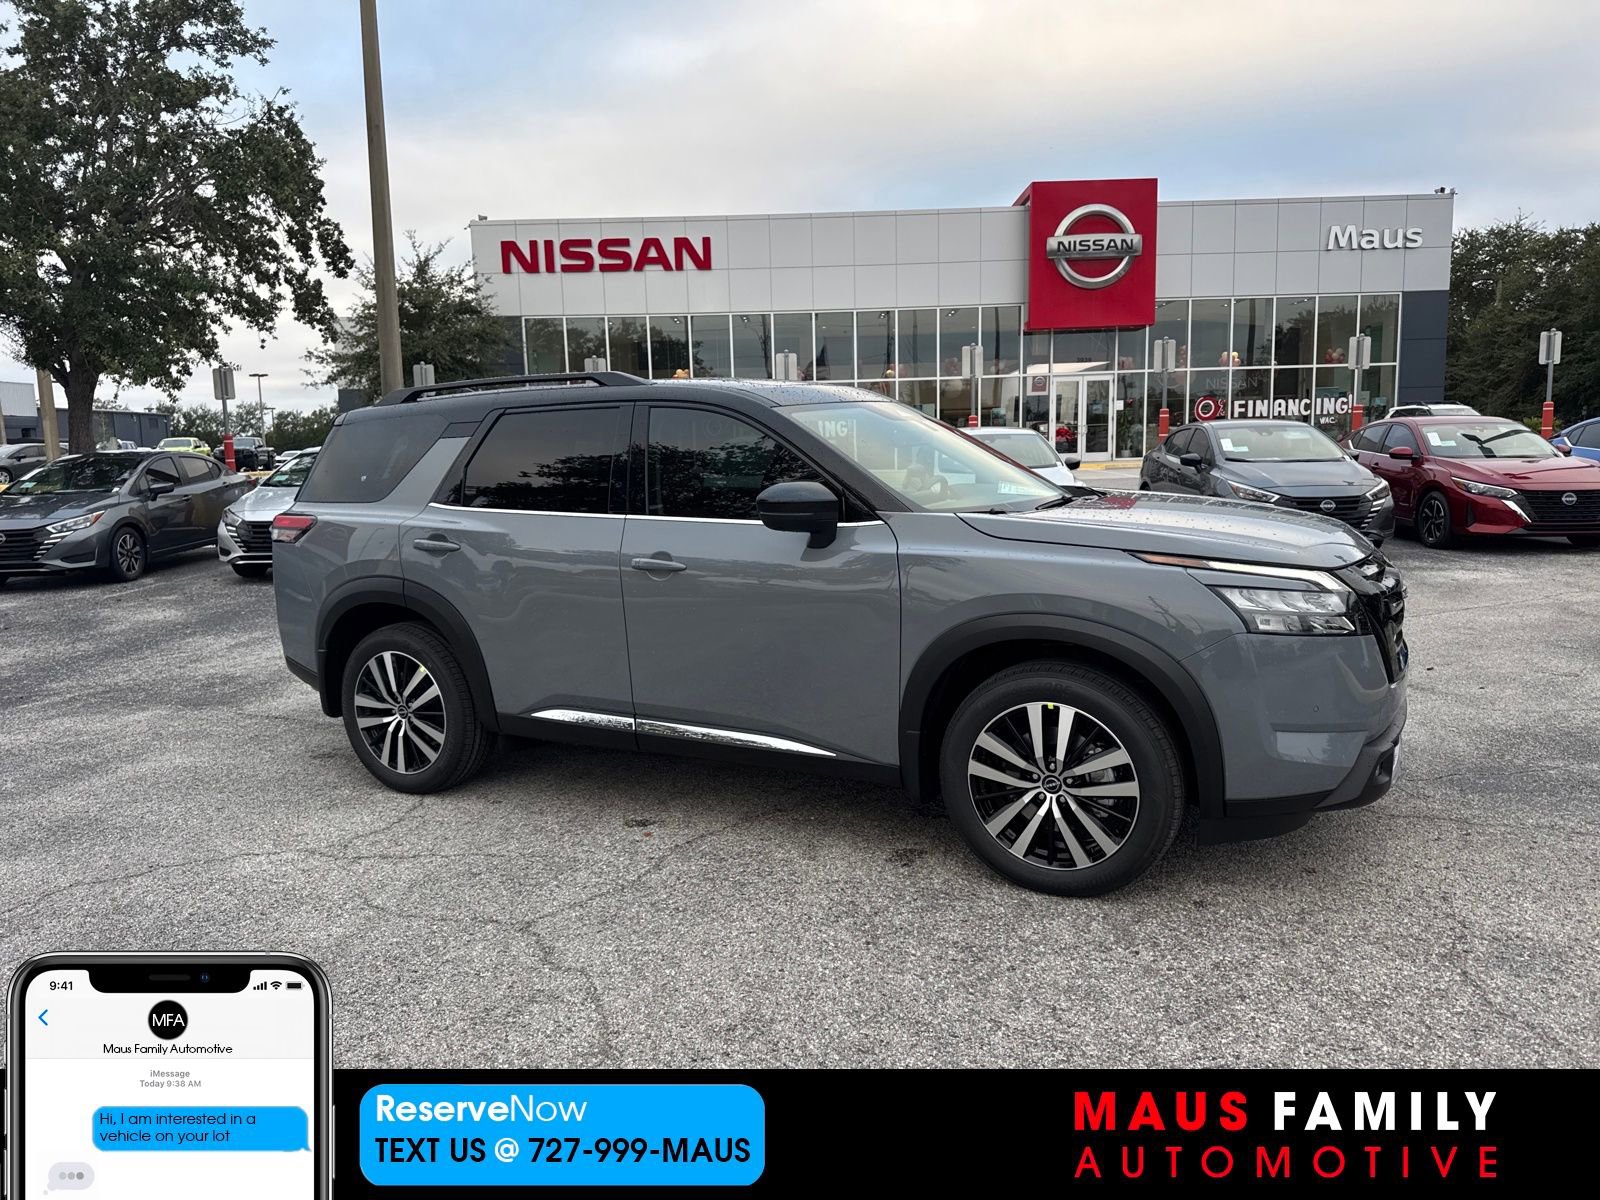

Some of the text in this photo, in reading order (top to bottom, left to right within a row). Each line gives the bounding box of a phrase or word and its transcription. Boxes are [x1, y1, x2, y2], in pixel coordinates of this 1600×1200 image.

[1055, 237, 1135, 254] NISSAN
[1326, 224, 1425, 251] Maus
[500, 236, 712, 274] NISSAN
[1233, 393, 1353, 418] FINANCING!
